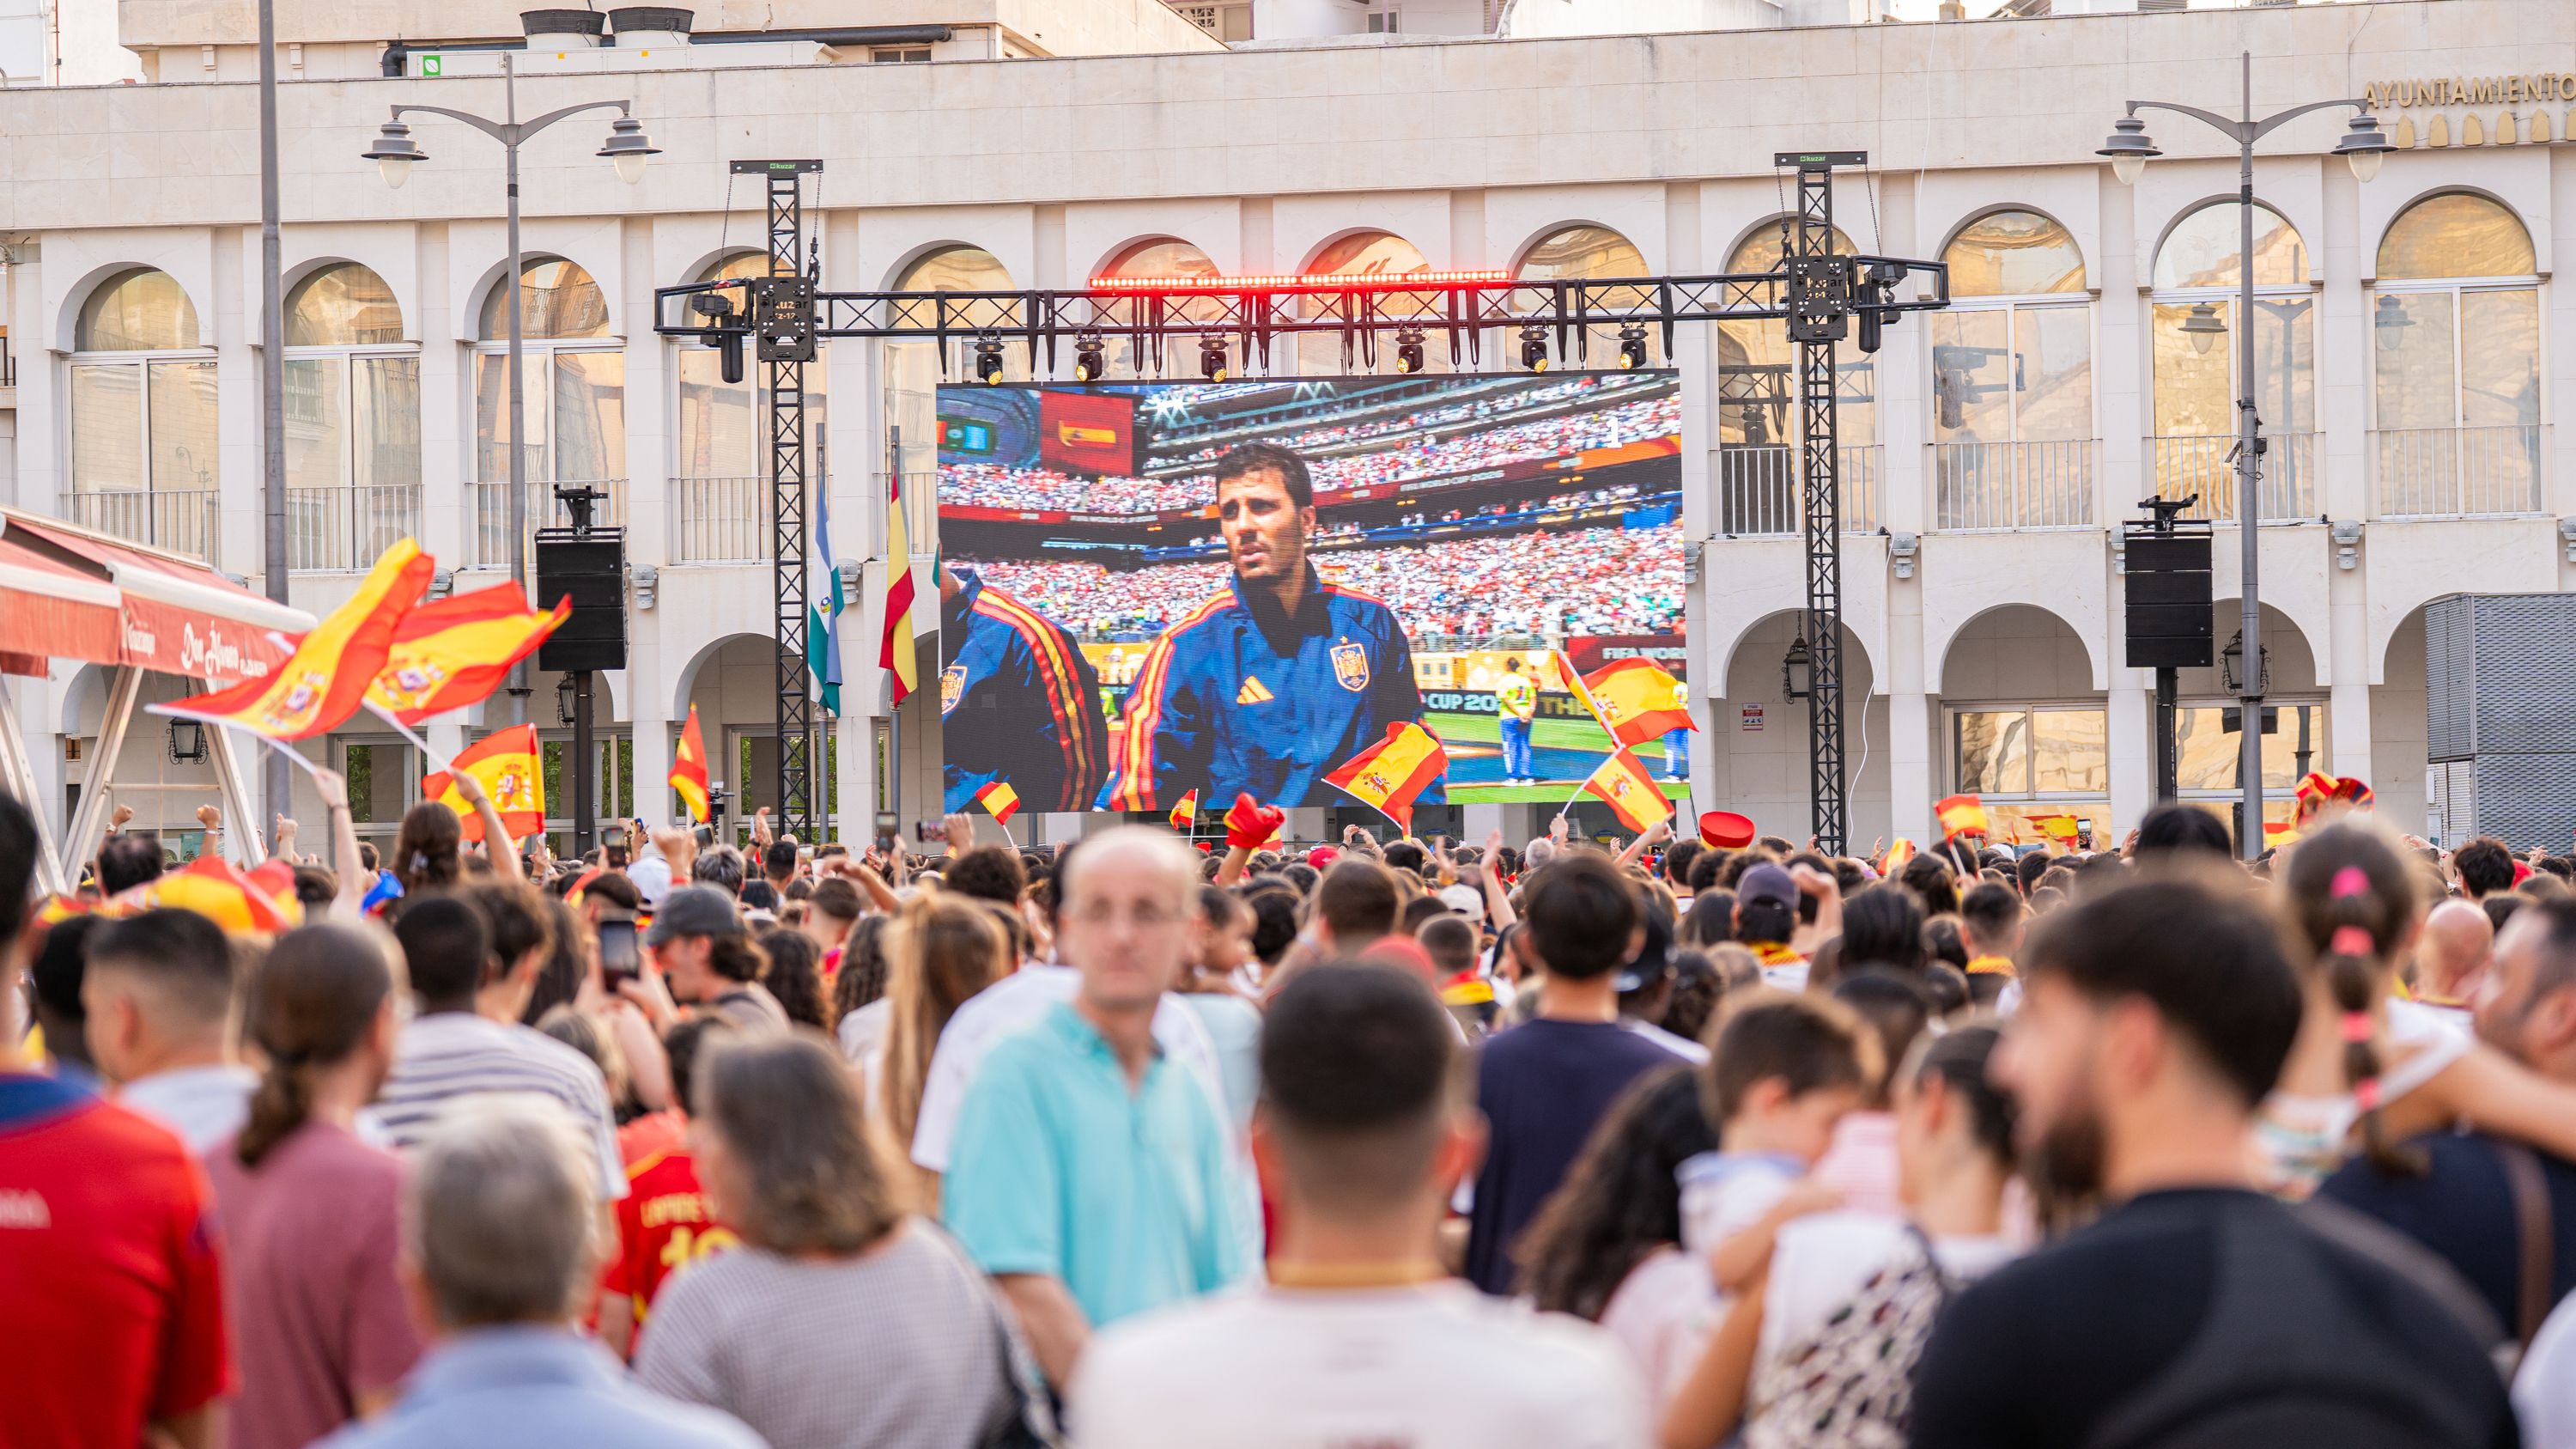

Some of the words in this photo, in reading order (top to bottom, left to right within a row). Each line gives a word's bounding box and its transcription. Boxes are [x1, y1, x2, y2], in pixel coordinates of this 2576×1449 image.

[2364, 73, 2576, 108] AYUNTAMIENTO
[773, 300, 808, 309] kuzar
[1427, 693, 1463, 709] CUP
